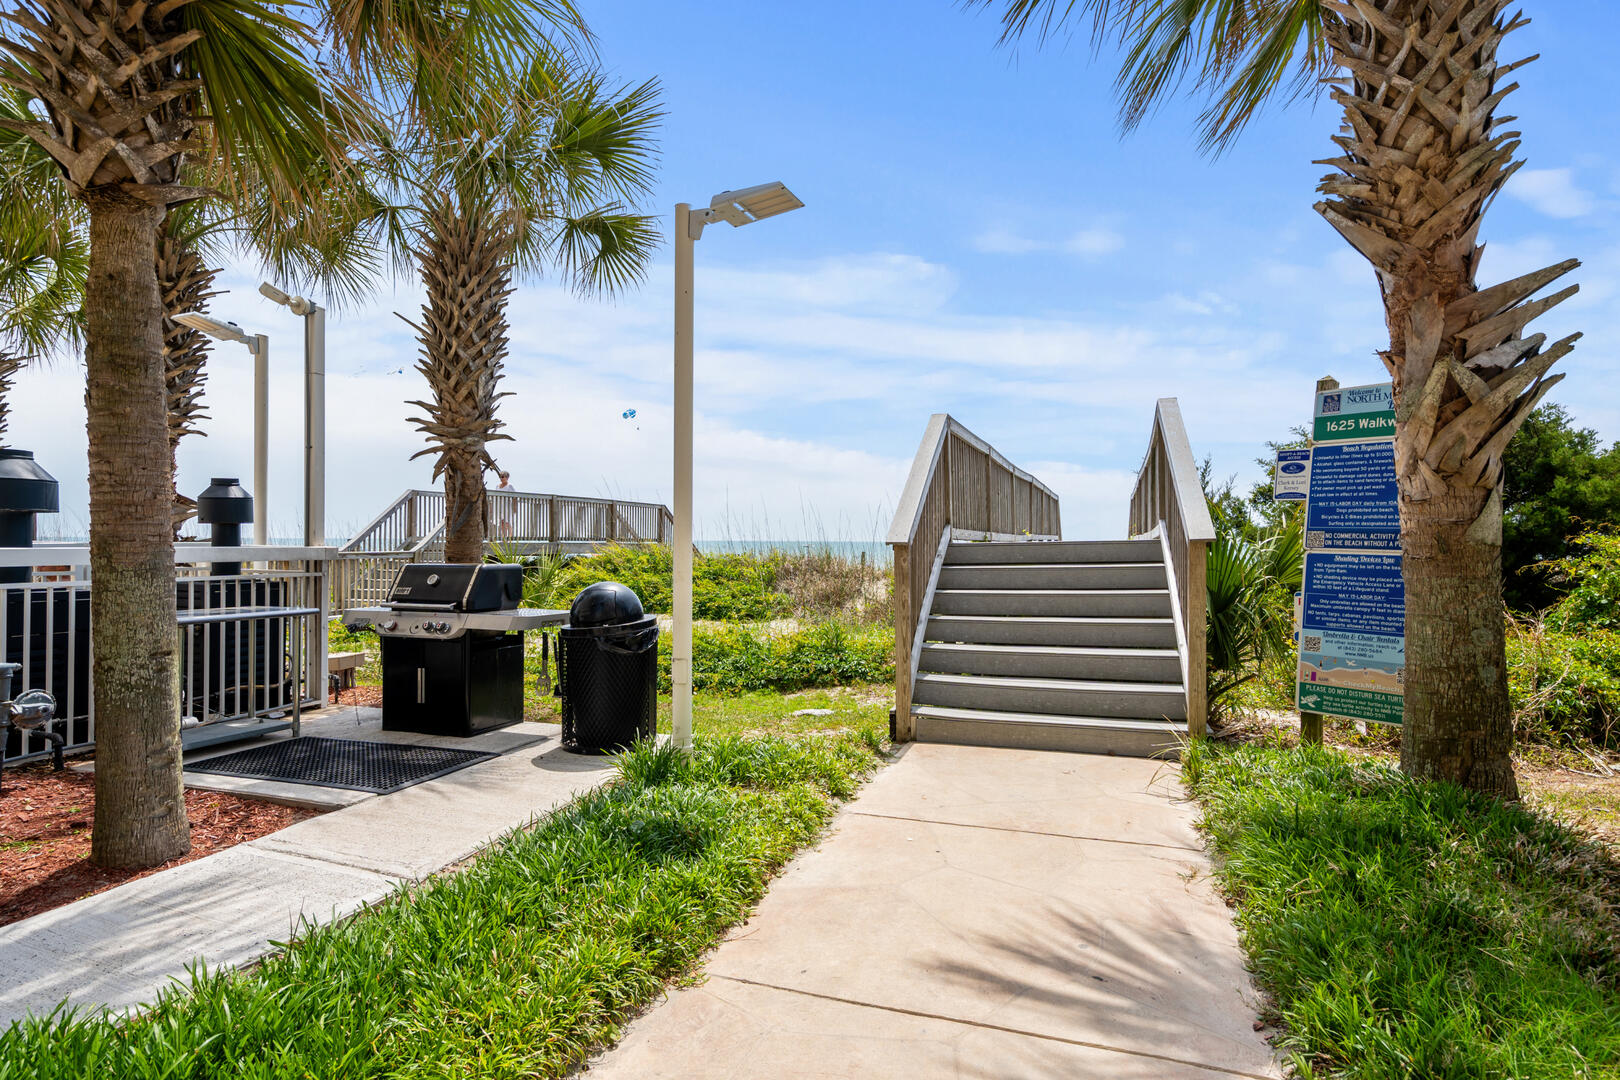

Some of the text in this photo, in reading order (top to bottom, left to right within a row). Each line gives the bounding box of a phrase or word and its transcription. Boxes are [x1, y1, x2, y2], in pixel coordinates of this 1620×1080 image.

[1348, 393, 1381, 403] NORTH
[1327, 417, 1396, 432] 1625 Walkw
[1334, 555, 1359, 563] Shading
[1322, 631, 1350, 640] Umbrella
[1376, 636, 1400, 644] Rentals
[1306, 684, 1327, 693] PLEASE
[1349, 690, 1373, 699] DISTURB
